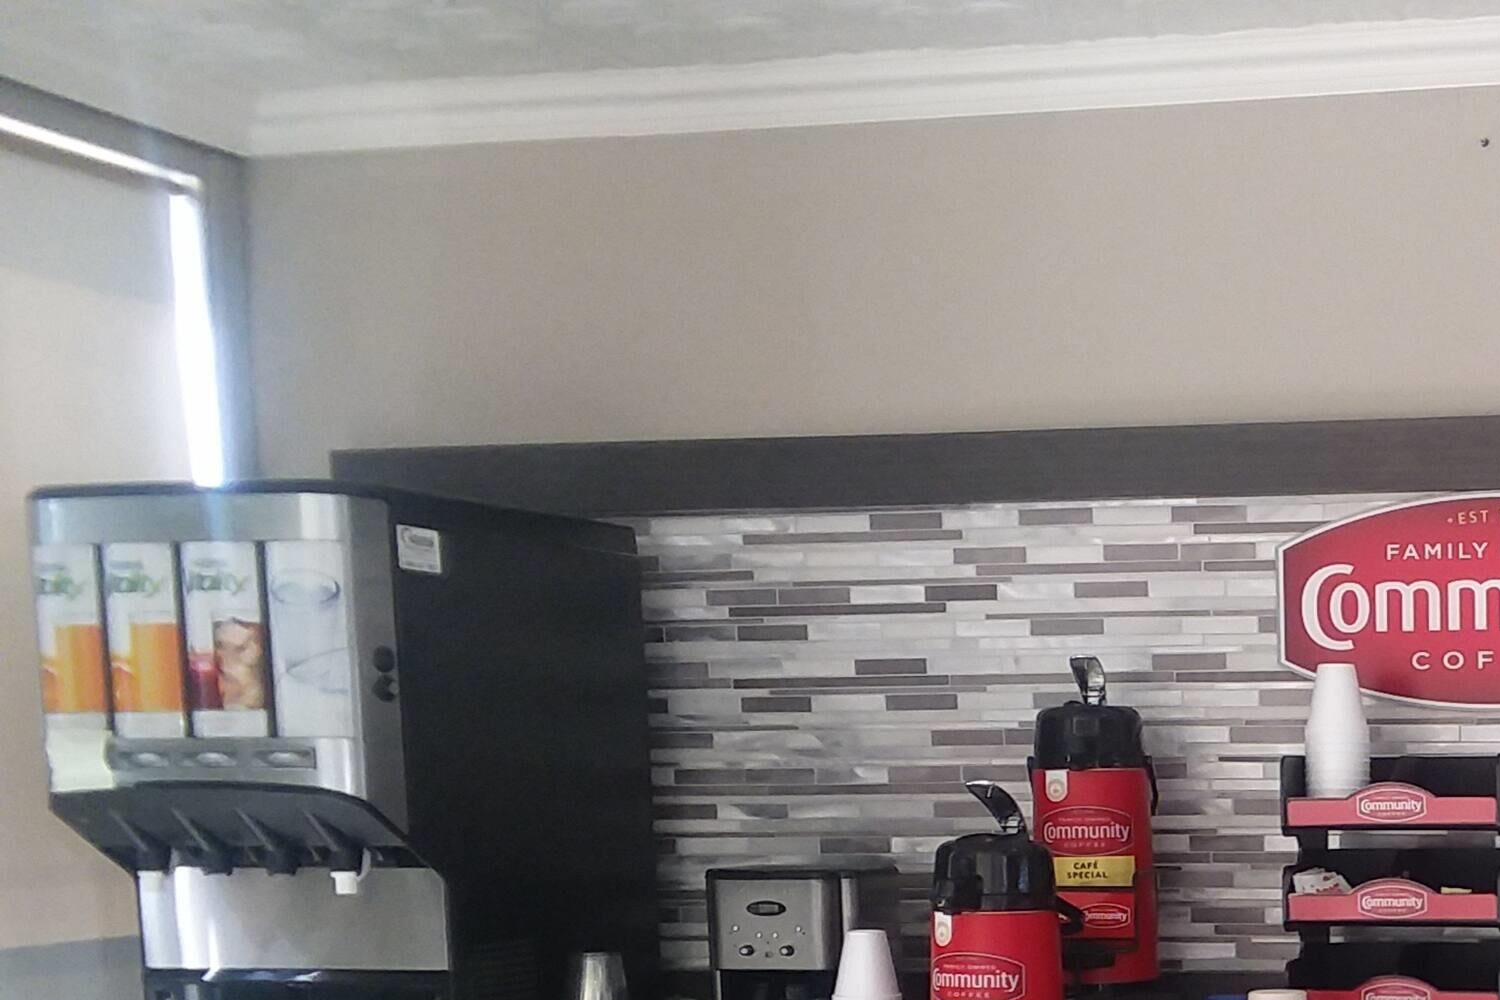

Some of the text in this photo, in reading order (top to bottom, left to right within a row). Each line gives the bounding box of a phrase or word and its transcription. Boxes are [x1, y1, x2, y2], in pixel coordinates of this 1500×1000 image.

[1457, 509, 1489, 525] EST
[1386, 540, 1489, 561] FAMILY
[1361, 798, 1422, 814] Community
[1043, 821, 1130, 844] Community
[1073, 860, 1098, 870] CAFÉ
[1067, 871, 1109, 880] SPECIAL
[1361, 895, 1423, 910] Community
[932, 967, 1019, 993] Community
